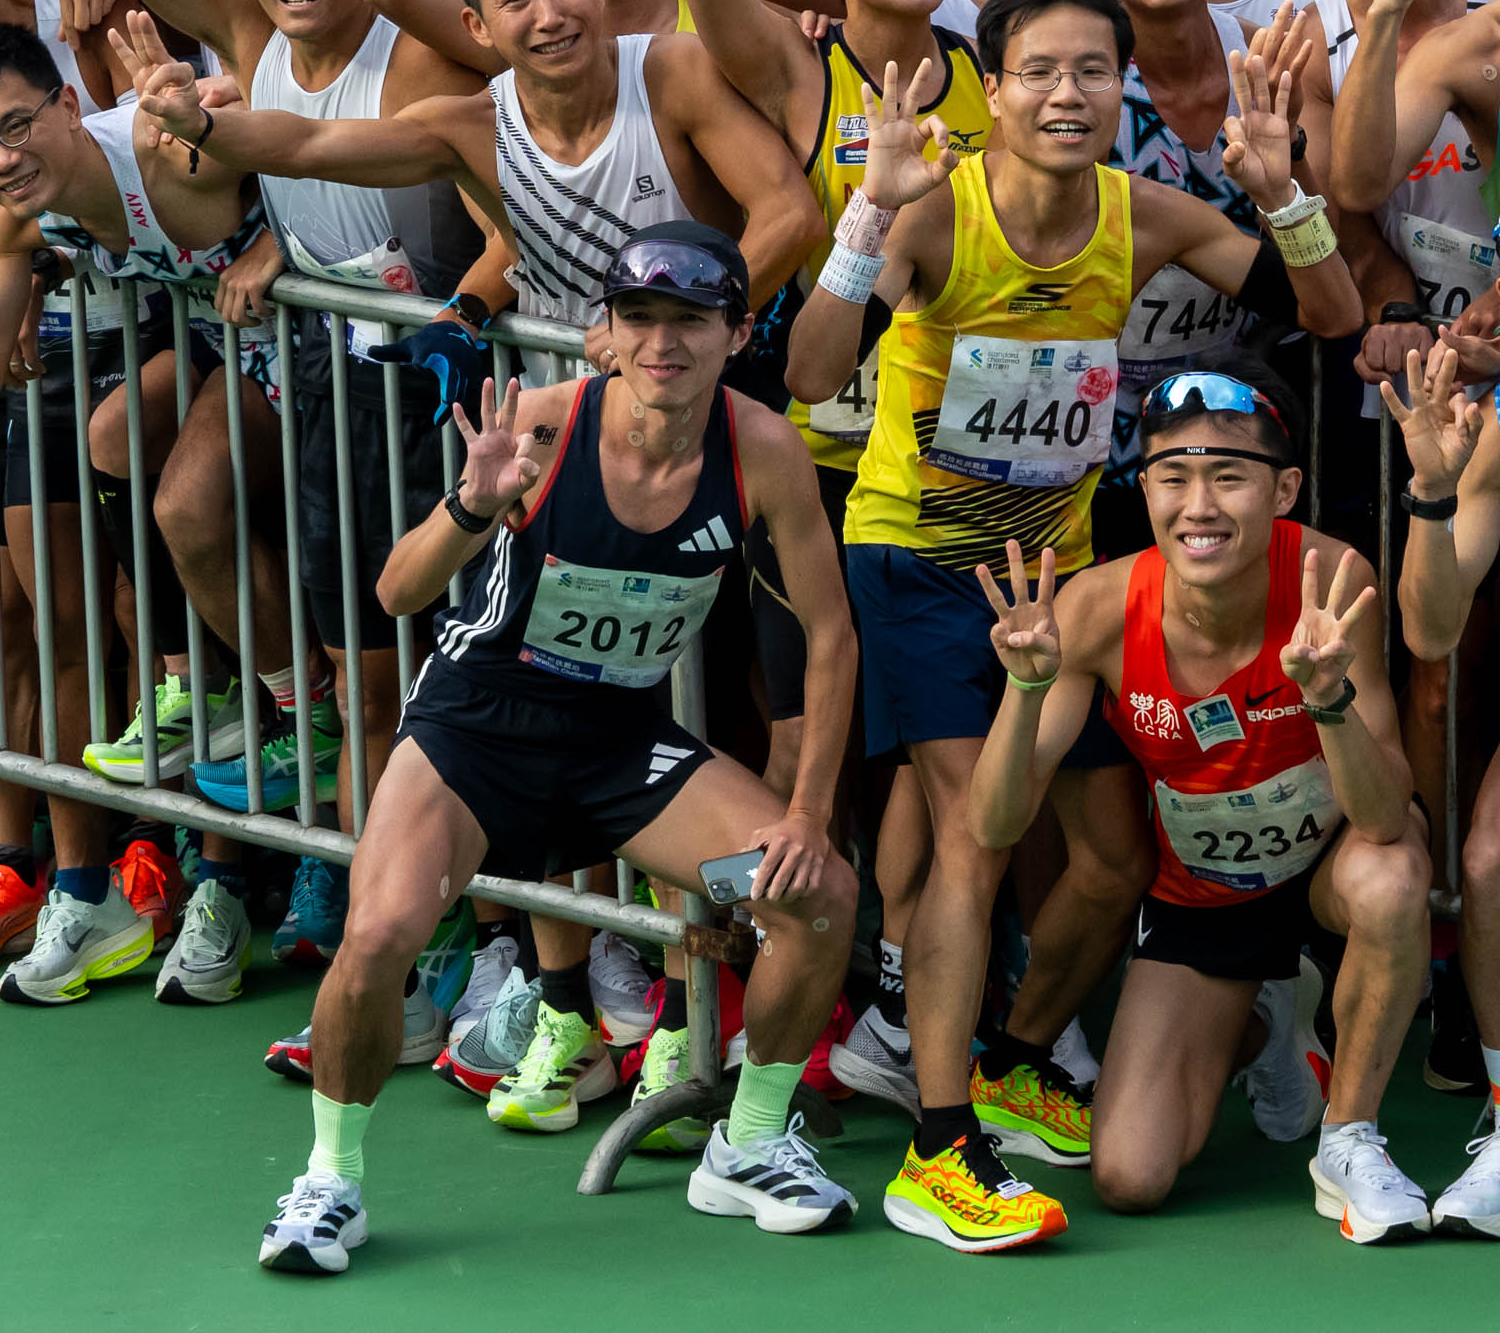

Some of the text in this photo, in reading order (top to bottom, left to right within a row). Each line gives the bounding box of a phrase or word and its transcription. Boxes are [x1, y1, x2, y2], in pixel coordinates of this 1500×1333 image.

[966, 398, 1090, 447] 4440
[1182, 446, 1204, 455] NIKE
[552, 608, 688, 659] 2012
[1133, 722, 1184, 741] LCRA
[1191, 812, 1327, 865] 2234
